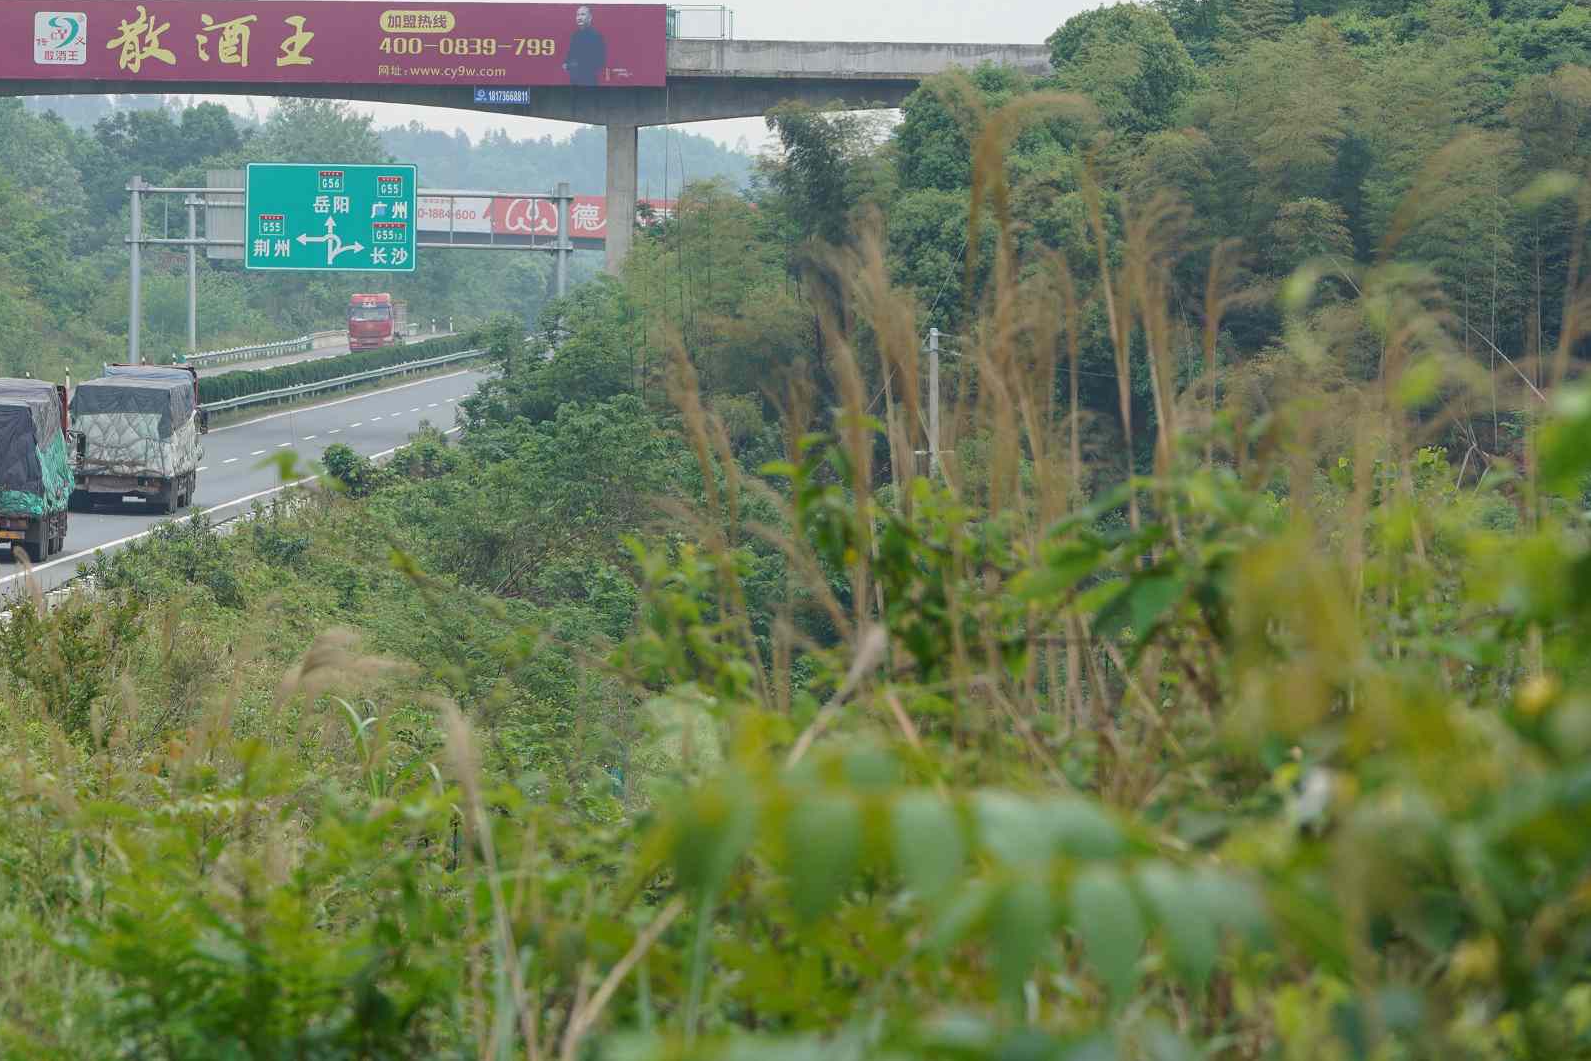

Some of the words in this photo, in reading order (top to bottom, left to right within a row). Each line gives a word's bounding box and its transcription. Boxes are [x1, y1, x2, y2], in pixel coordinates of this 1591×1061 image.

[387, 13, 448, 29] 加盟热线
[106, 5, 315, 73] 散酒王
[379, 37, 556, 56] 400-0839-799
[322, 179, 340, 188] G56
[381, 184, 399, 194] G55
[313, 195, 350, 214] 岳阳
[370, 201, 408, 219] 广州
[571, 203, 608, 231] 德
[263, 222, 281, 232] G55
[253, 238, 291, 257] 荆州
[370, 246, 408, 265] 长沙
